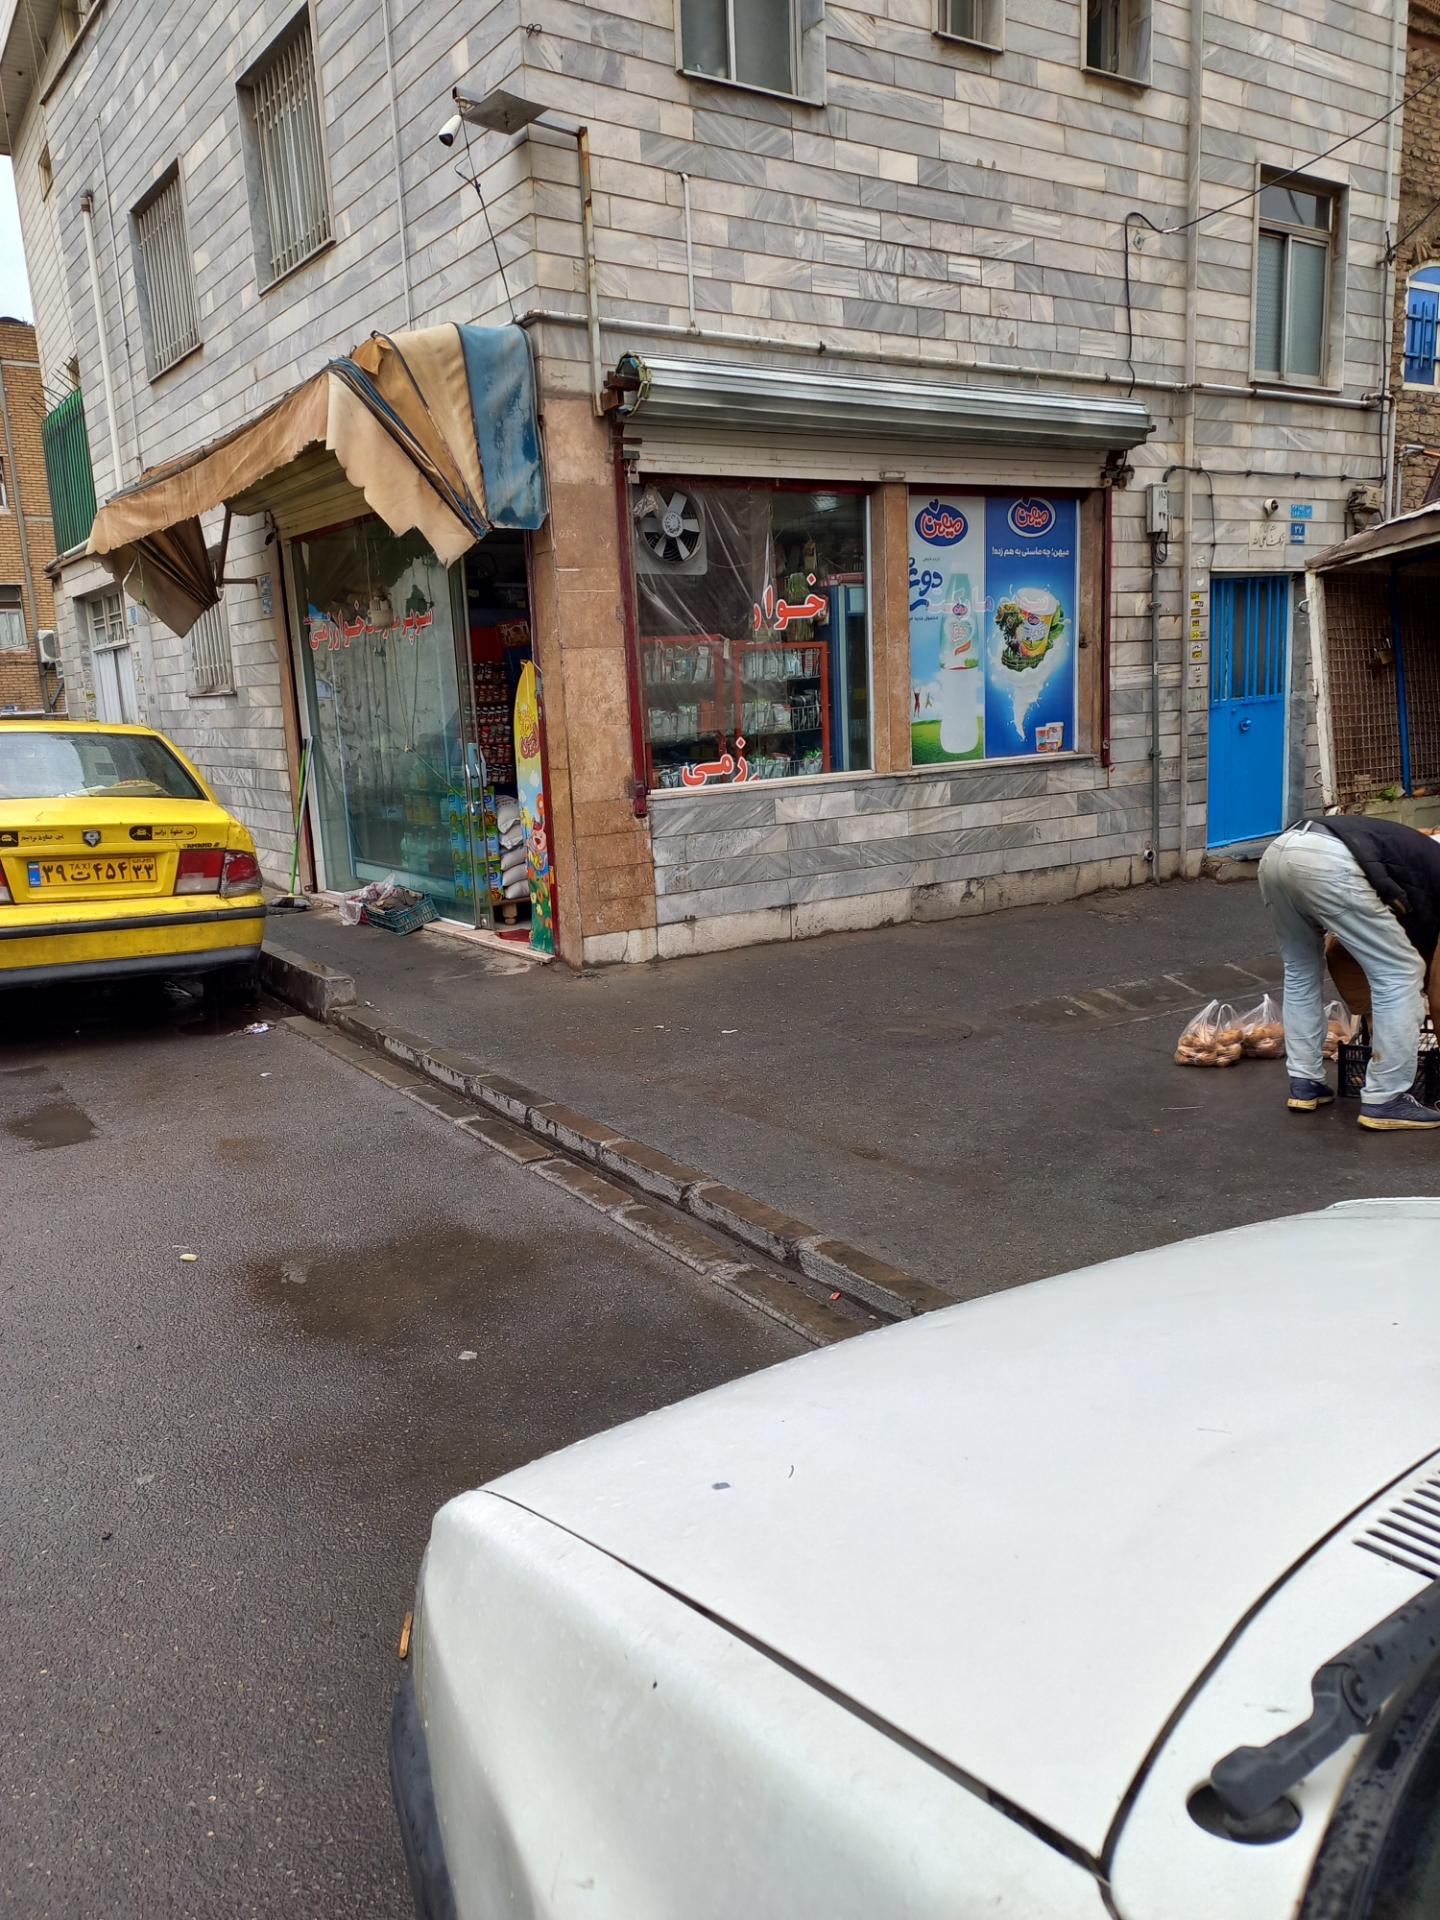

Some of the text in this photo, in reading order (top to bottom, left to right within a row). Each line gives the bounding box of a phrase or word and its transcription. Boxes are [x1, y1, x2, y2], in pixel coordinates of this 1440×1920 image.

[920, 512, 963, 538] میهن
[1015, 506, 1050, 527] میهن
[402, 608, 433, 645] سوپر
[42, 864, 67, 883] ۳۹
[92, 862, 128, 881] ۴۵۴
[132, 863, 154, 880] ۳۳
[70, 862, 91, 870] TAXI
